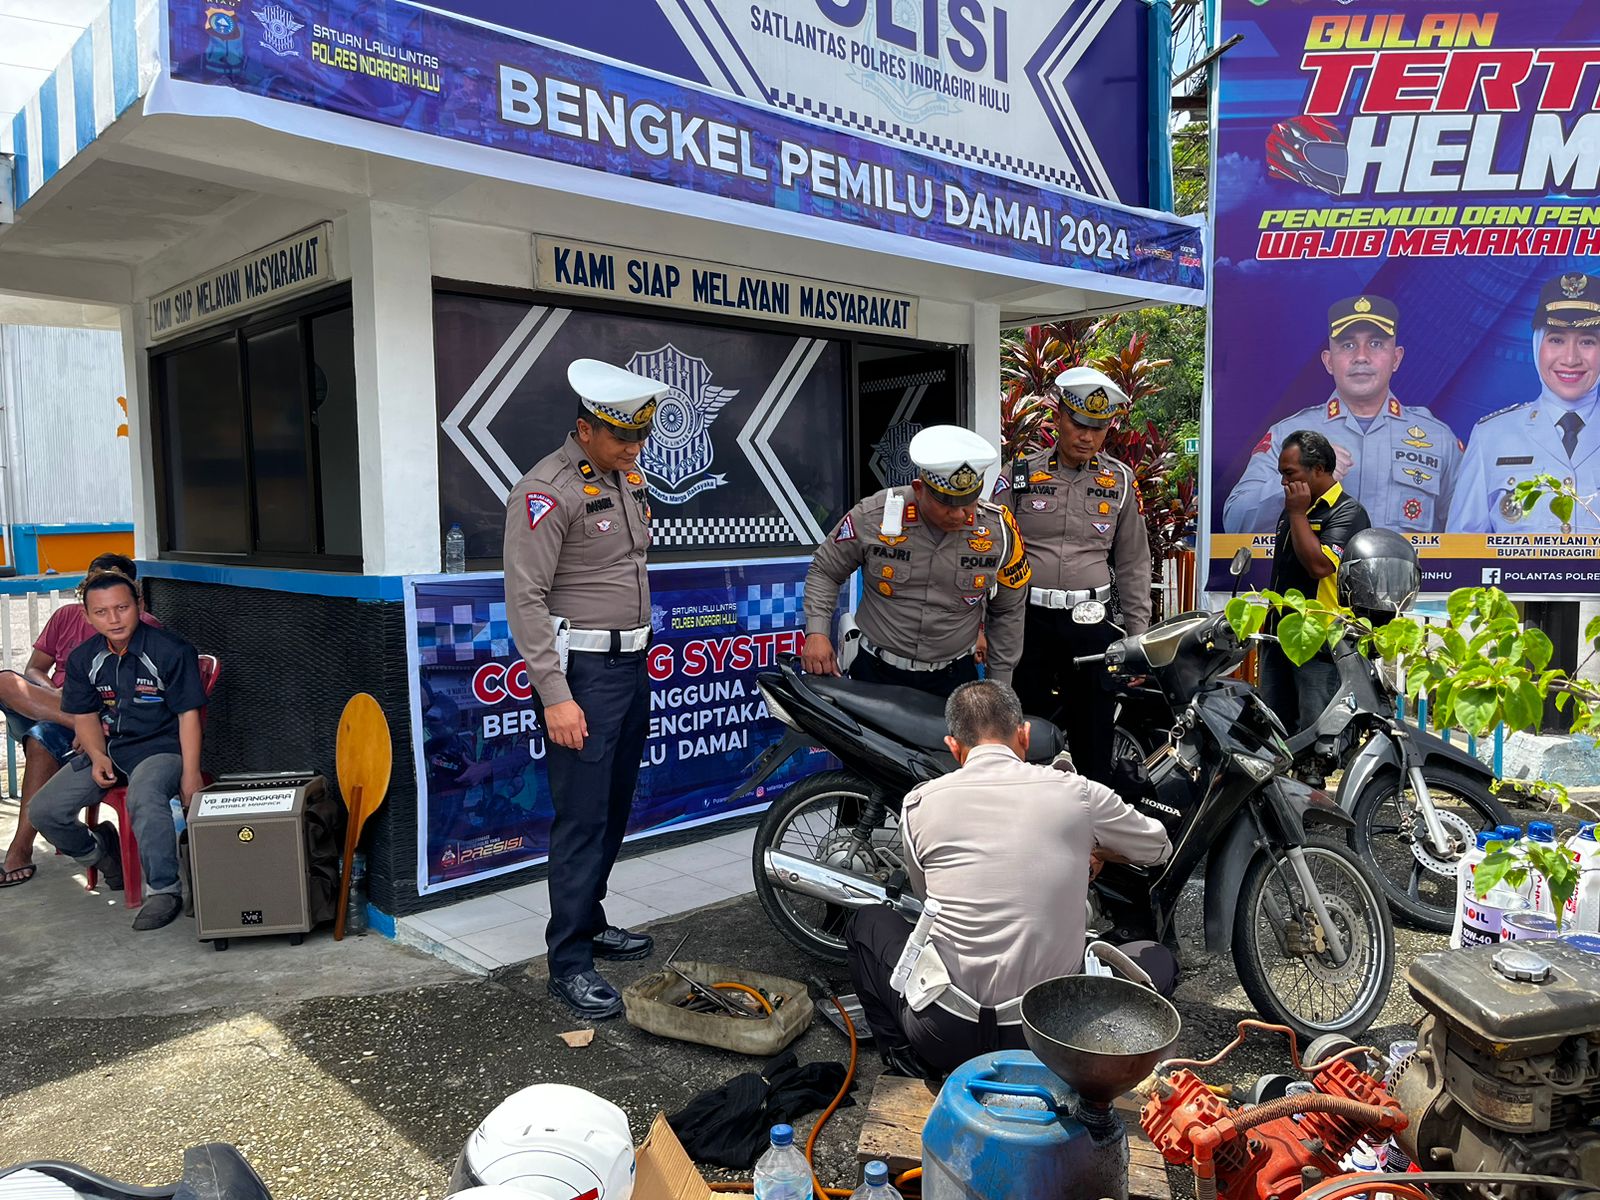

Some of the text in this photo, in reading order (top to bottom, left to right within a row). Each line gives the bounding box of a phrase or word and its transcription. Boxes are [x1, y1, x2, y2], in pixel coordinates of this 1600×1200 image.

[312, 23, 439, 70] SATUAN LALU LINTAS
[1304, 12, 1499, 50] BULAN
[311, 41, 441, 93] POLRES INDRAGIRI HULU
[750, 4, 846, 61] SATLANTAS
[850, 39, 907, 81] POLRES
[909, 61, 976, 104] INDRAGIRI
[978, 84, 1010, 114] HULU
[1300, 48, 1600, 116] TERT
[498, 64, 1131, 262] BENGKEL PEMILU DAMAI 2024
[1342, 113, 1600, 194] HELM
[1258, 206, 1459, 229] PENGEMUDI
[1460, 206, 1533, 225] DAN
[1256, 229, 1387, 260] WAJIB
[1387, 227, 1572, 258] MEMAKAI
[153, 236, 319, 333] KAMI SIAP MELAYANI MASYARAKAT
[553, 246, 911, 330] KAMI SIAP MELAYANI MASYARAKAT
[1395, 450, 1439, 469] POLRI
[1087, 487, 1119, 500] POLRI
[1411, 535, 1440, 545] S.I.K
[1487, 536, 1530, 545] REZITA
[1533, 536, 1587, 545] MEYLANI
[1497, 548, 1596, 557] BUPATI INDRAGIRI
[1504, 572, 1563, 581] POLANTAS
[1565, 572, 1600, 581] POLRE
[671, 602, 737, 616] SATUAN LALU LINTAS
[671, 612, 738, 630] POLRES INDRAGIRI HULU
[483, 678, 746, 739] BER NGGUNA
[646, 700, 775, 740] ENCIPTAKA
[678, 729, 748, 761] DAMAI
[221, 793, 292, 804] BHAYANGKARA
[1140, 796, 1182, 818] HONDA
